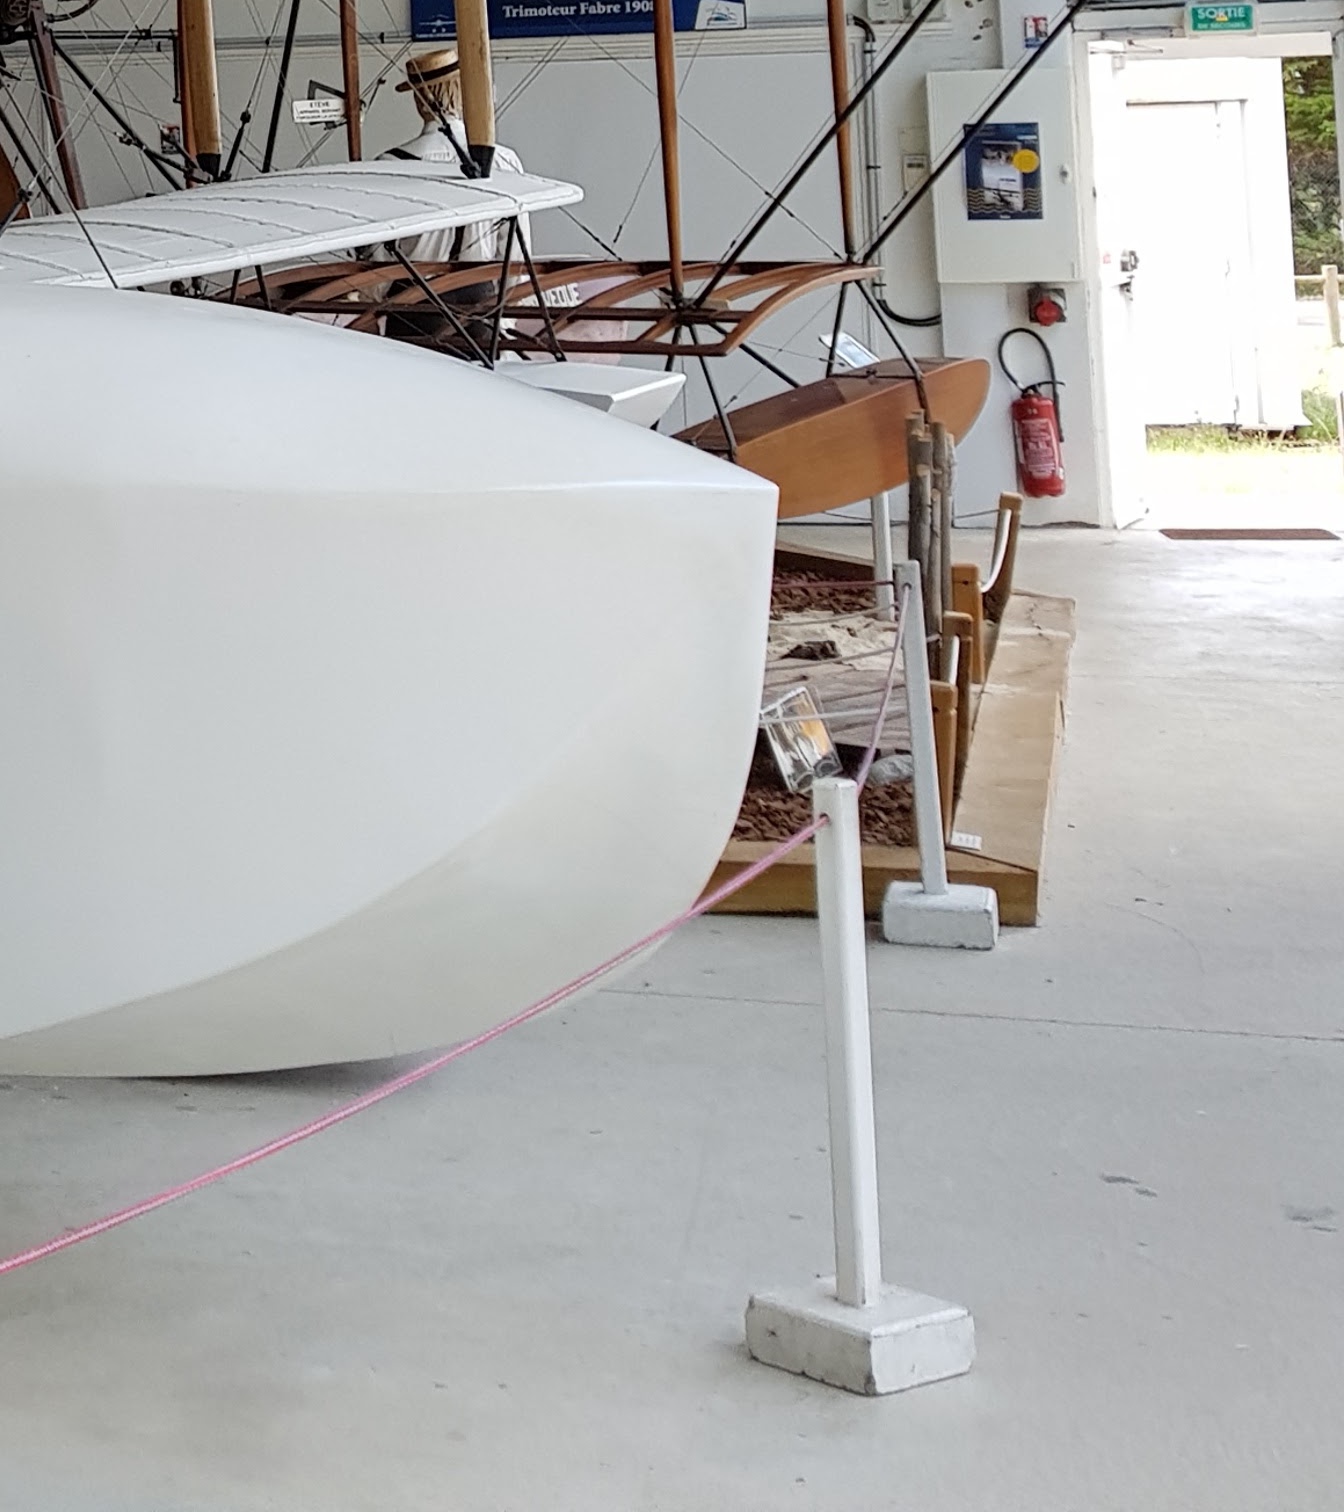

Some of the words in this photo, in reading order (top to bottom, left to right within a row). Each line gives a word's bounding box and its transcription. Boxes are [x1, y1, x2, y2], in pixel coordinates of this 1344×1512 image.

[502, 4, 577, 18] Trimoteur
[580, 1, 621, 15] Fabre
[1197, 6, 1246, 20] SORTIE
